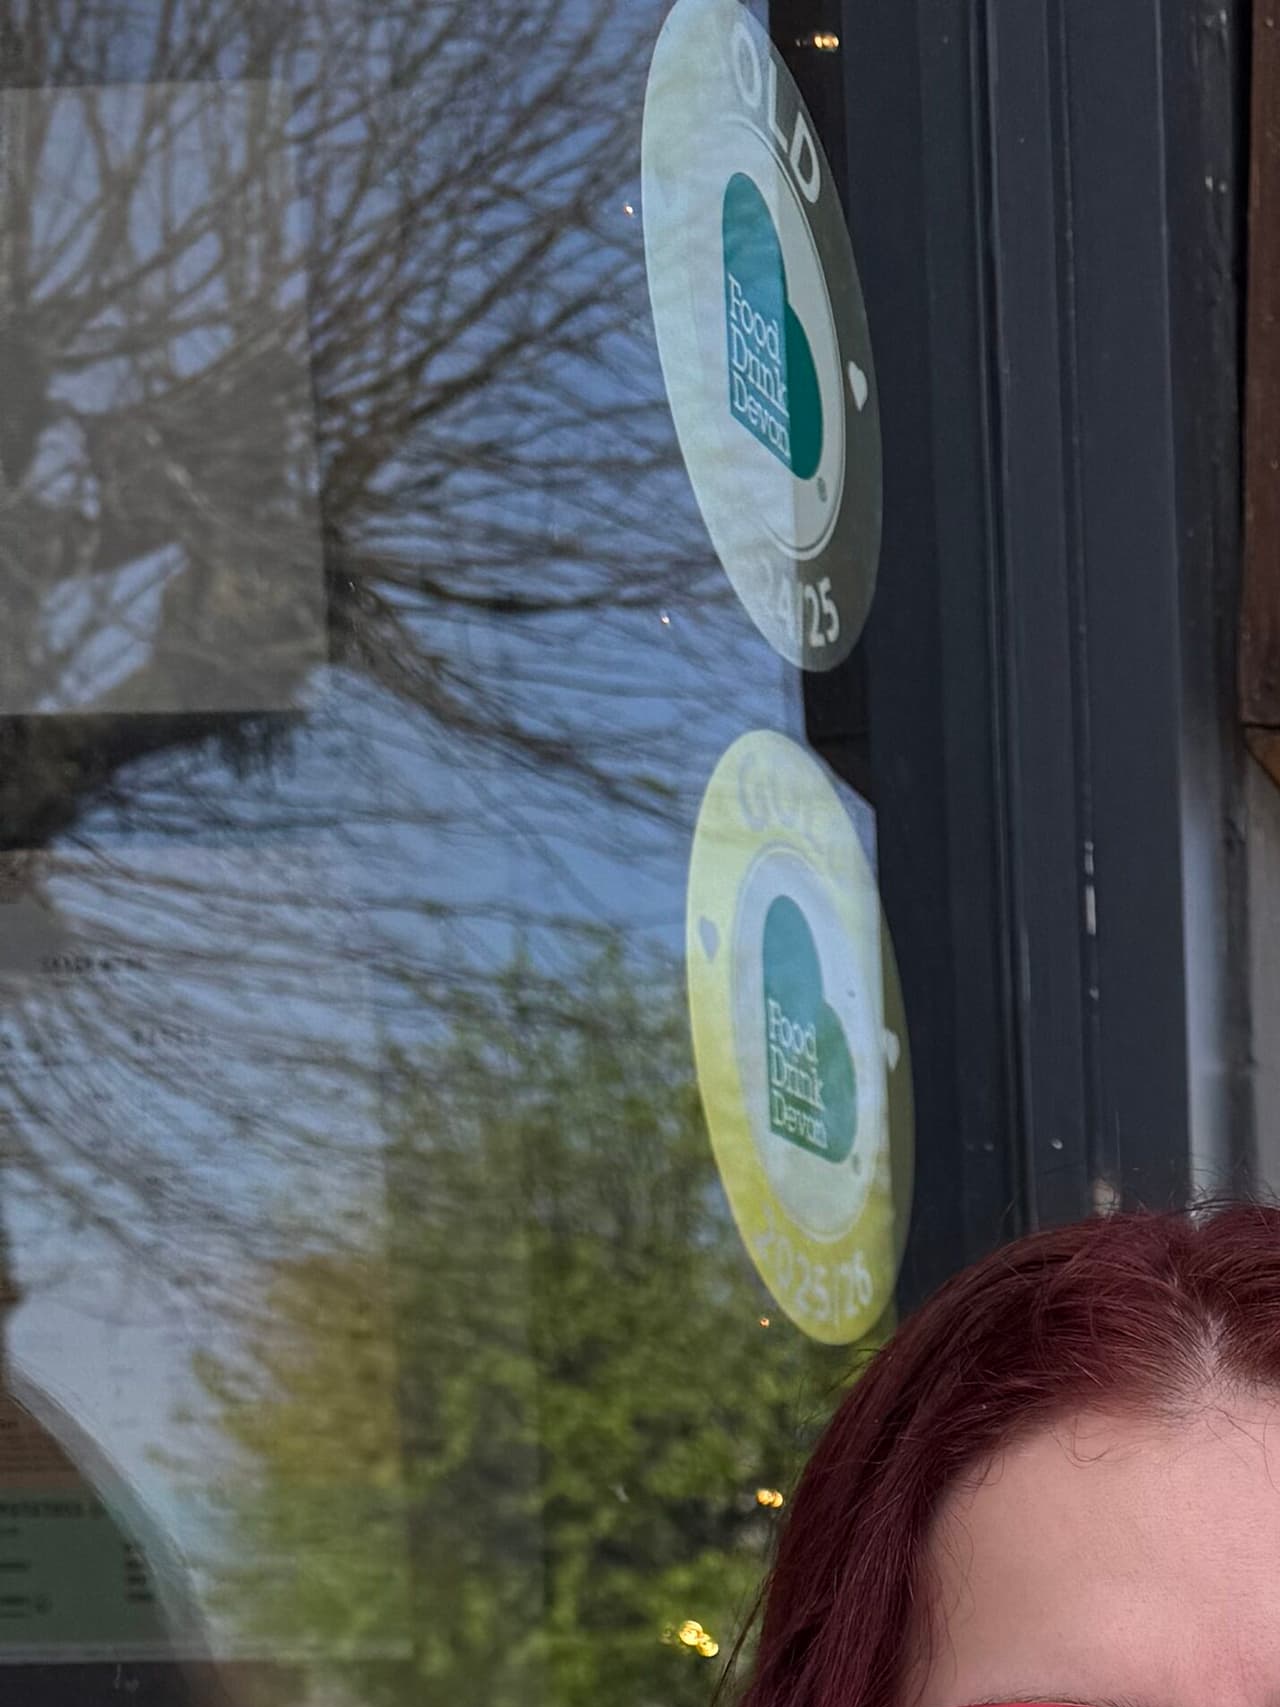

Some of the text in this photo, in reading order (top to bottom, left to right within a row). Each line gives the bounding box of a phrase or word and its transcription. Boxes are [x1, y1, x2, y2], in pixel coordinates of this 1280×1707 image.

[732, 20, 822, 204] OLD
[727, 271, 782, 366] Food
[730, 321, 790, 419] Drink
[732, 371, 792, 461] Devon
[767, 998, 820, 1065] Food
[769, 1043, 826, 1113] Drink
[771, 1086, 829, 1149] Devon
